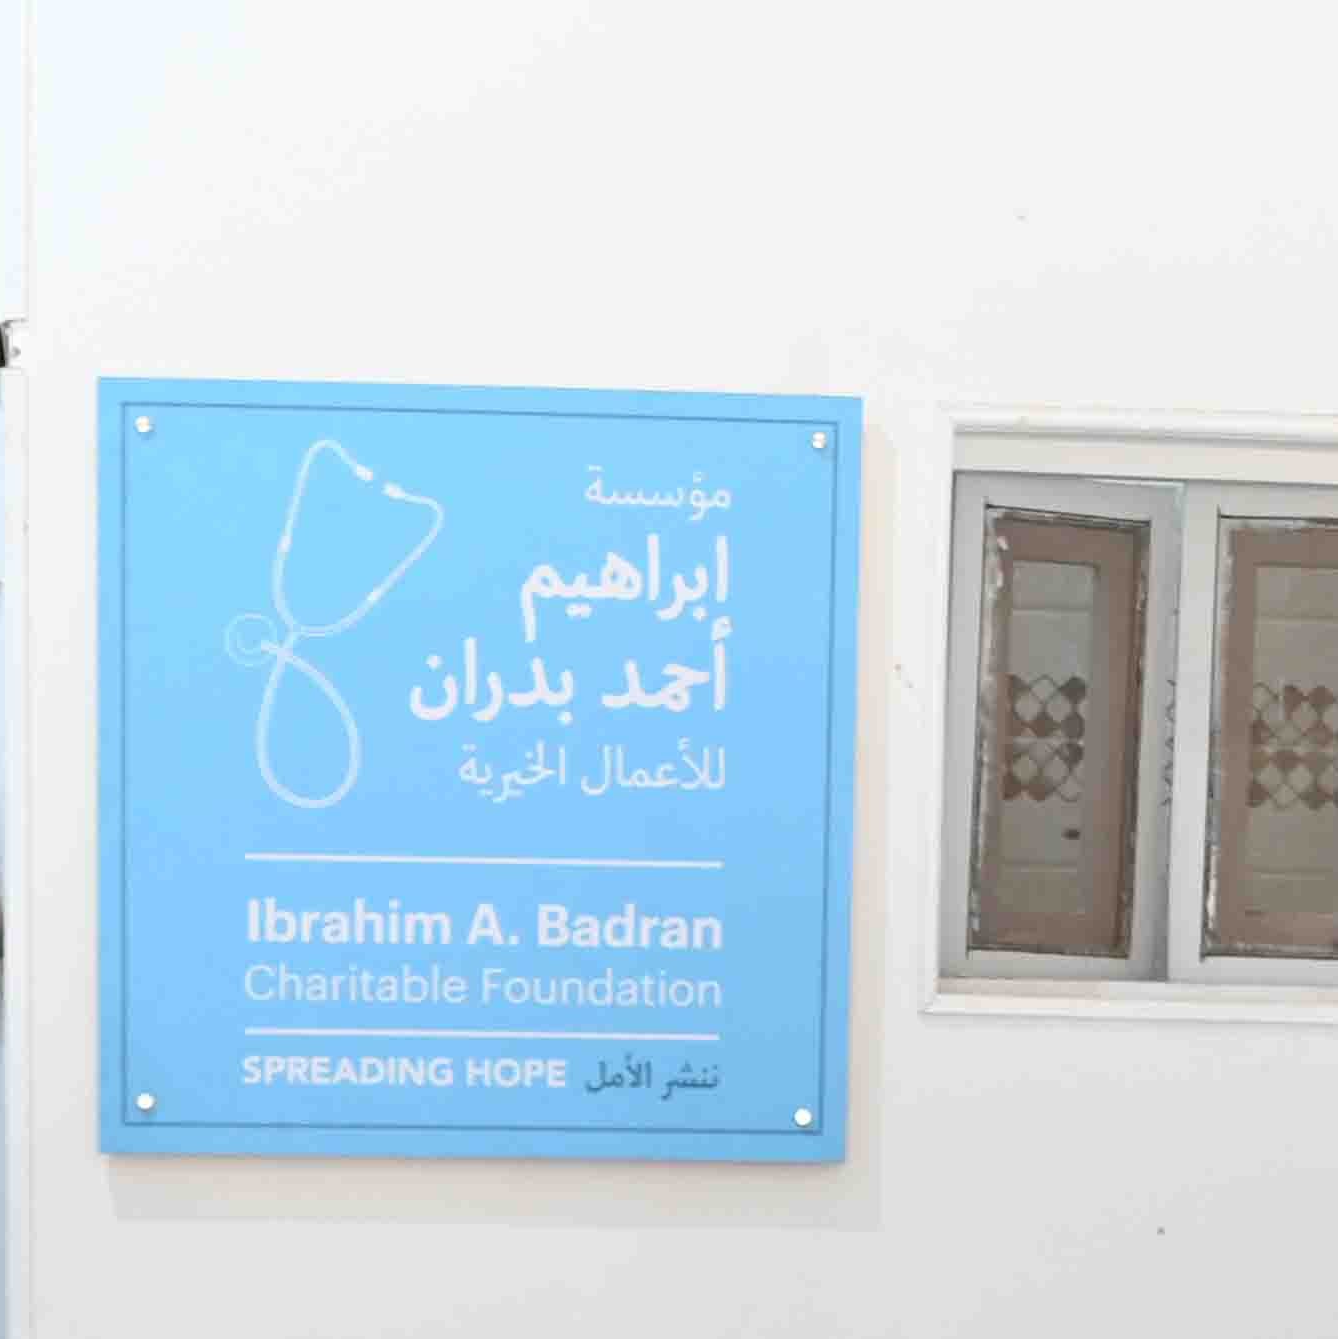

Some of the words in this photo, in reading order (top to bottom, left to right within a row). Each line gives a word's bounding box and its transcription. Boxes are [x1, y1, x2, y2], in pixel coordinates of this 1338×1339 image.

[584, 465, 732, 522] مؤسسة
[520, 532, 731, 644] ابراهيم
[409, 636, 576, 726] بدران
[600, 615, 734, 713] أحمد
[458, 740, 566, 803] الخيرية
[580, 736, 726, 797] للأعمال
[246, 896, 454, 945] Ibrahim
[466, 903, 520, 946] A.
[537, 903, 723, 950] Badran
[244, 963, 469, 1004] Charitable
[483, 967, 723, 1009] Foundation
[242, 1055, 454, 1088] SPREADING
[466, 1056, 567, 1089] HOPE
[583, 1052, 653, 1095] الأمل
[660, 1060, 720, 1102] ننشر
